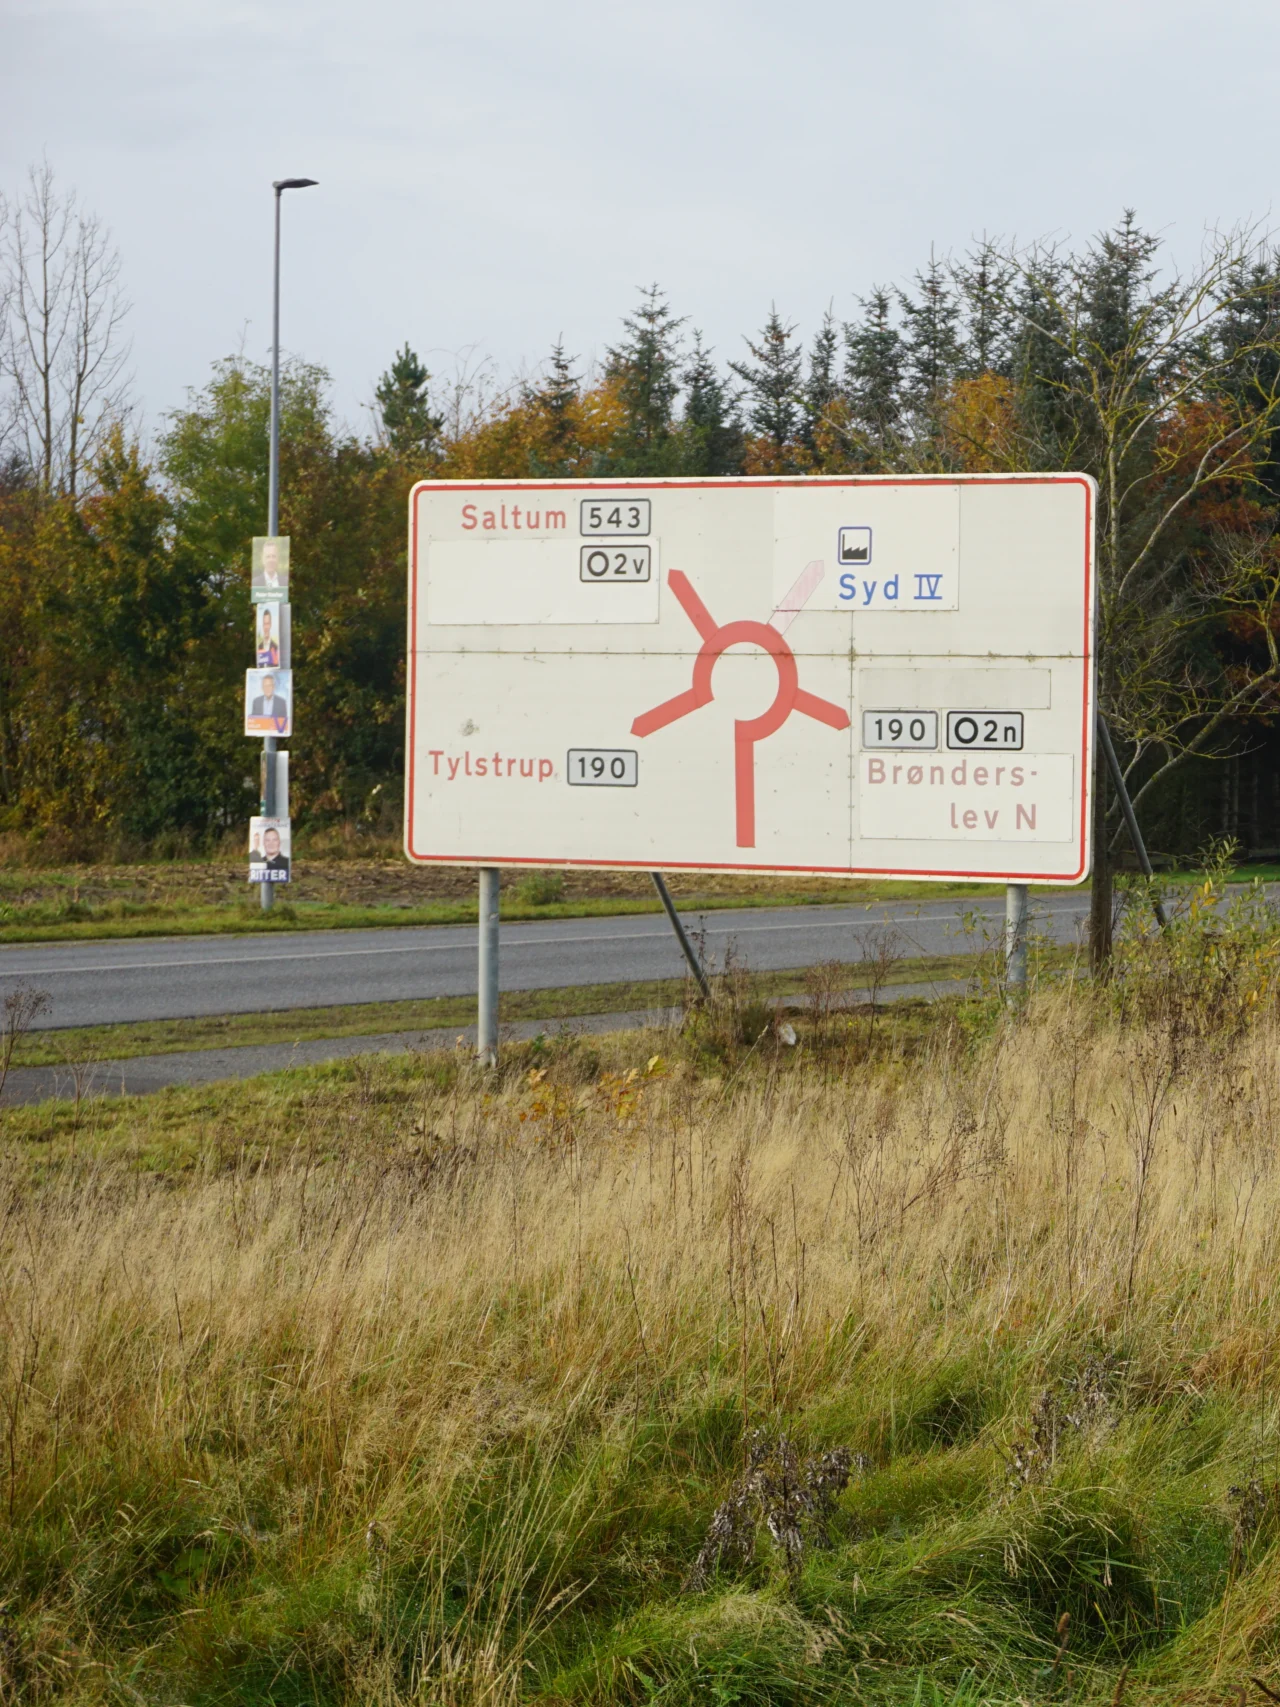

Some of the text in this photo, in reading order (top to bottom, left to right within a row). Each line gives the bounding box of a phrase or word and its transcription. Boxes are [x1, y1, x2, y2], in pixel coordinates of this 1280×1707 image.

[461, 504, 641, 530] Saltum 543
[838, 573, 943, 606] Syd IV
[875, 718, 926, 741] 190
[428, 750, 625, 783] Tylstrup 190
[868, 758, 1038, 787] Brønders-
[950, 802, 1037, 830] lev N
[250, 869, 287, 881] RITTER
